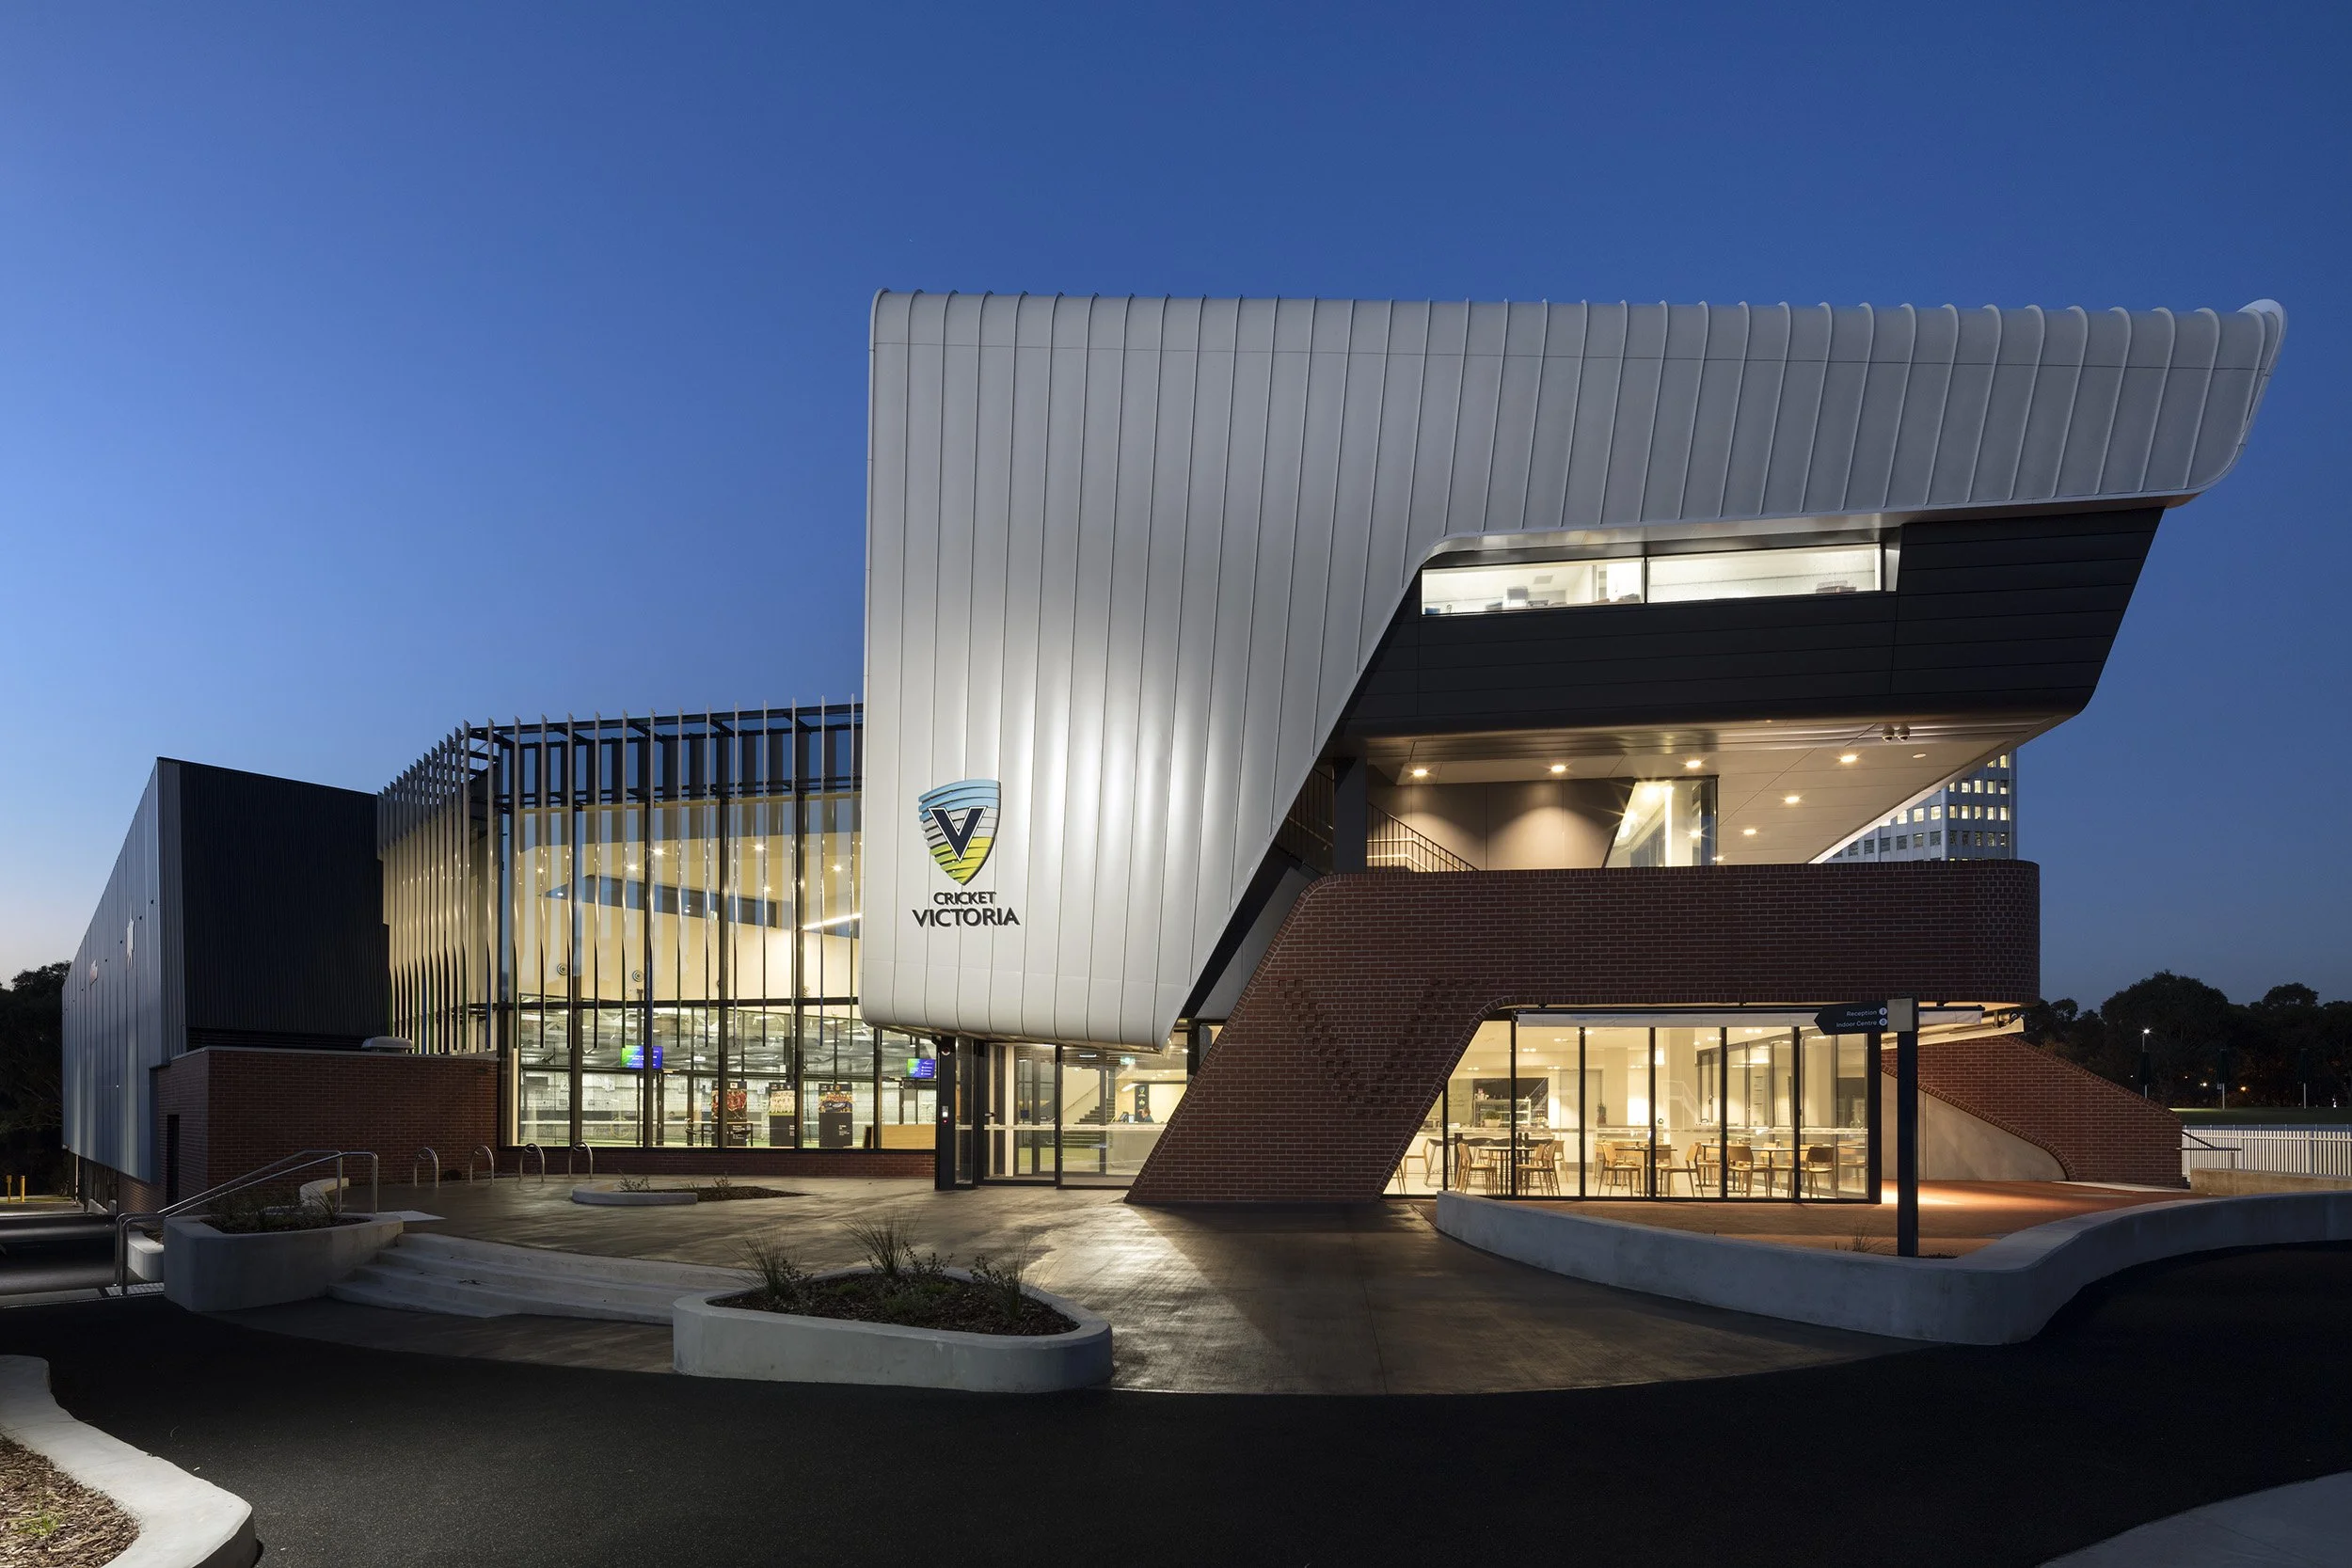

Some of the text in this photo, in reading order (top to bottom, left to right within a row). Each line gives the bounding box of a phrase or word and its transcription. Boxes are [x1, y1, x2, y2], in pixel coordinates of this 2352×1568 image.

[929, 806, 988, 863] V
[933, 891, 996, 906] CRICKET
[912, 907, 1020, 927] VICTORIA
